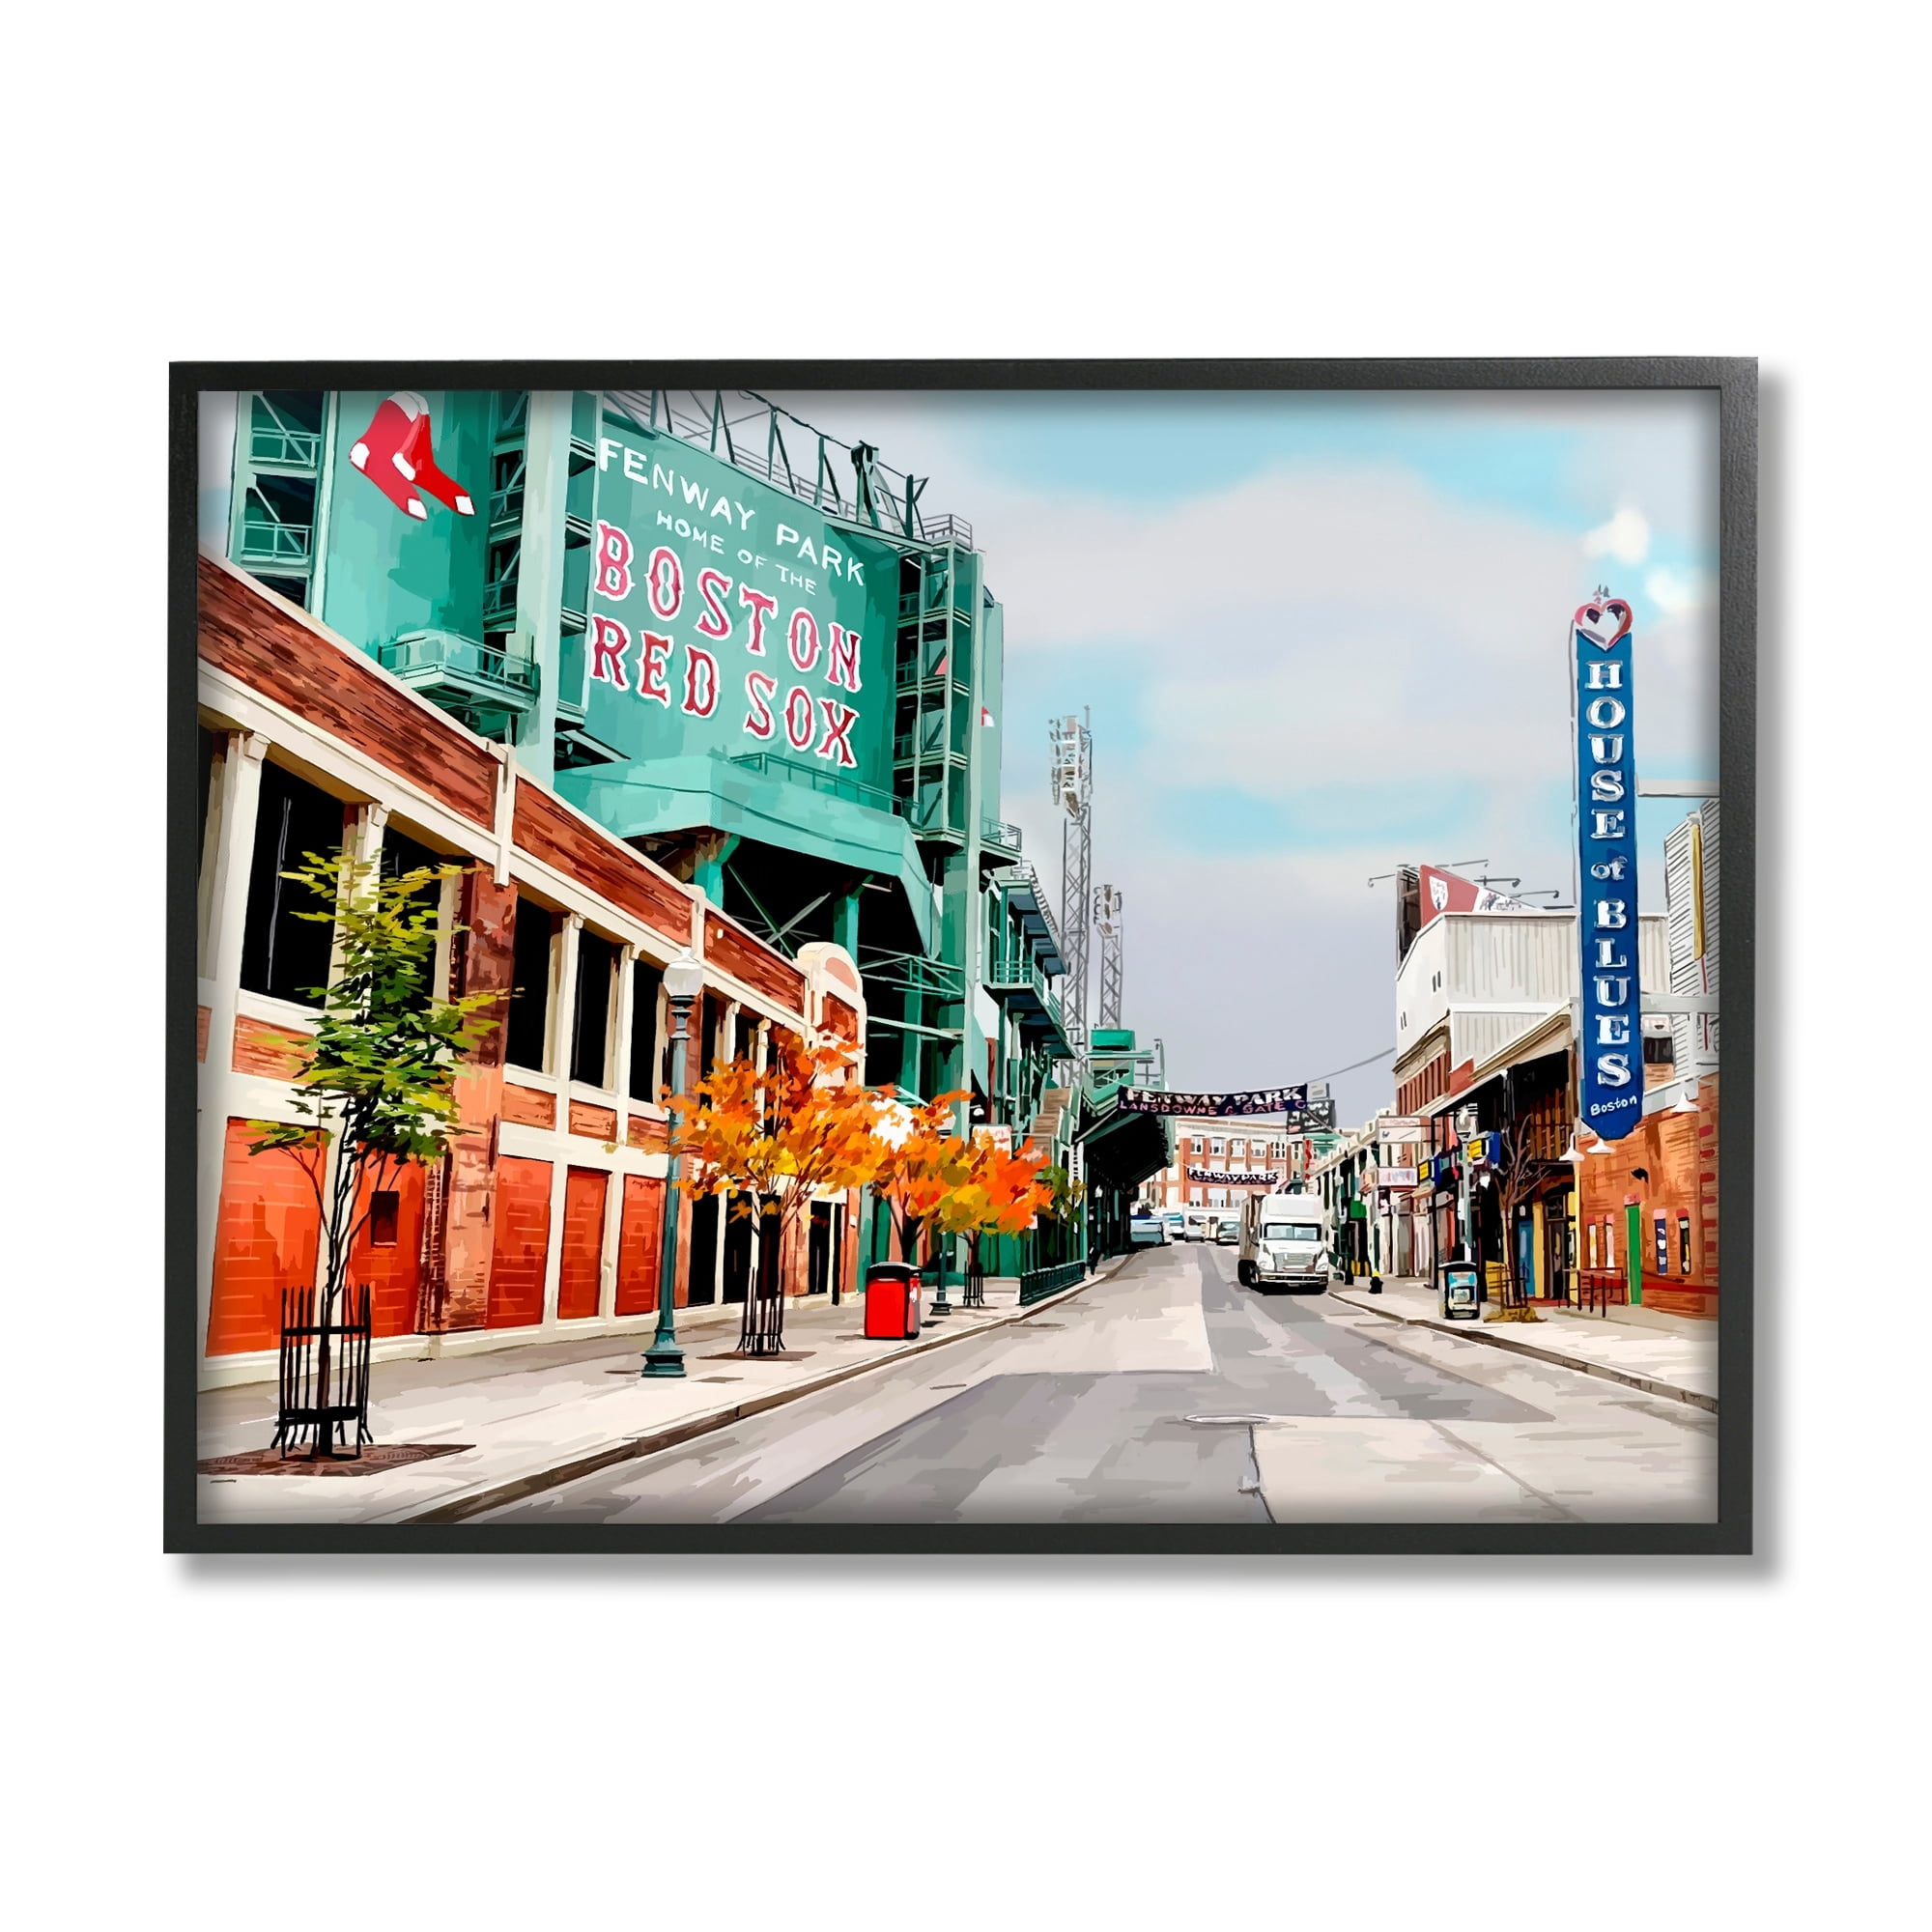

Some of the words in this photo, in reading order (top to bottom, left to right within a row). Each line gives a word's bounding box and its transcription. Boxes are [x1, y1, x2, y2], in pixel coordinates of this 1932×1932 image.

[599, 438, 755, 530] FENWAY
[776, 524, 865, 585] PARK
[657, 510, 724, 554] HOME
[737, 549, 768, 569] OF
[776, 563, 817, 595] THE
[594, 520, 863, 693] BOSTON
[590, 612, 721, 718] RED
[743, 669, 859, 768] SOX
[1584, 660, 1627, 839] HOUSE
[1591, 856, 1629, 881] of
[1593, 898, 1632, 1087] BLUES
[1120, 1100, 1218, 1116] LANSDOWNE
[1242, 1100, 1287, 1114] GATE
[1126, 1087, 1229, 1107] FENWAY
[1233, 1087, 1302, 1106] PARK
[1590, 1094, 1637, 1117] Boston
